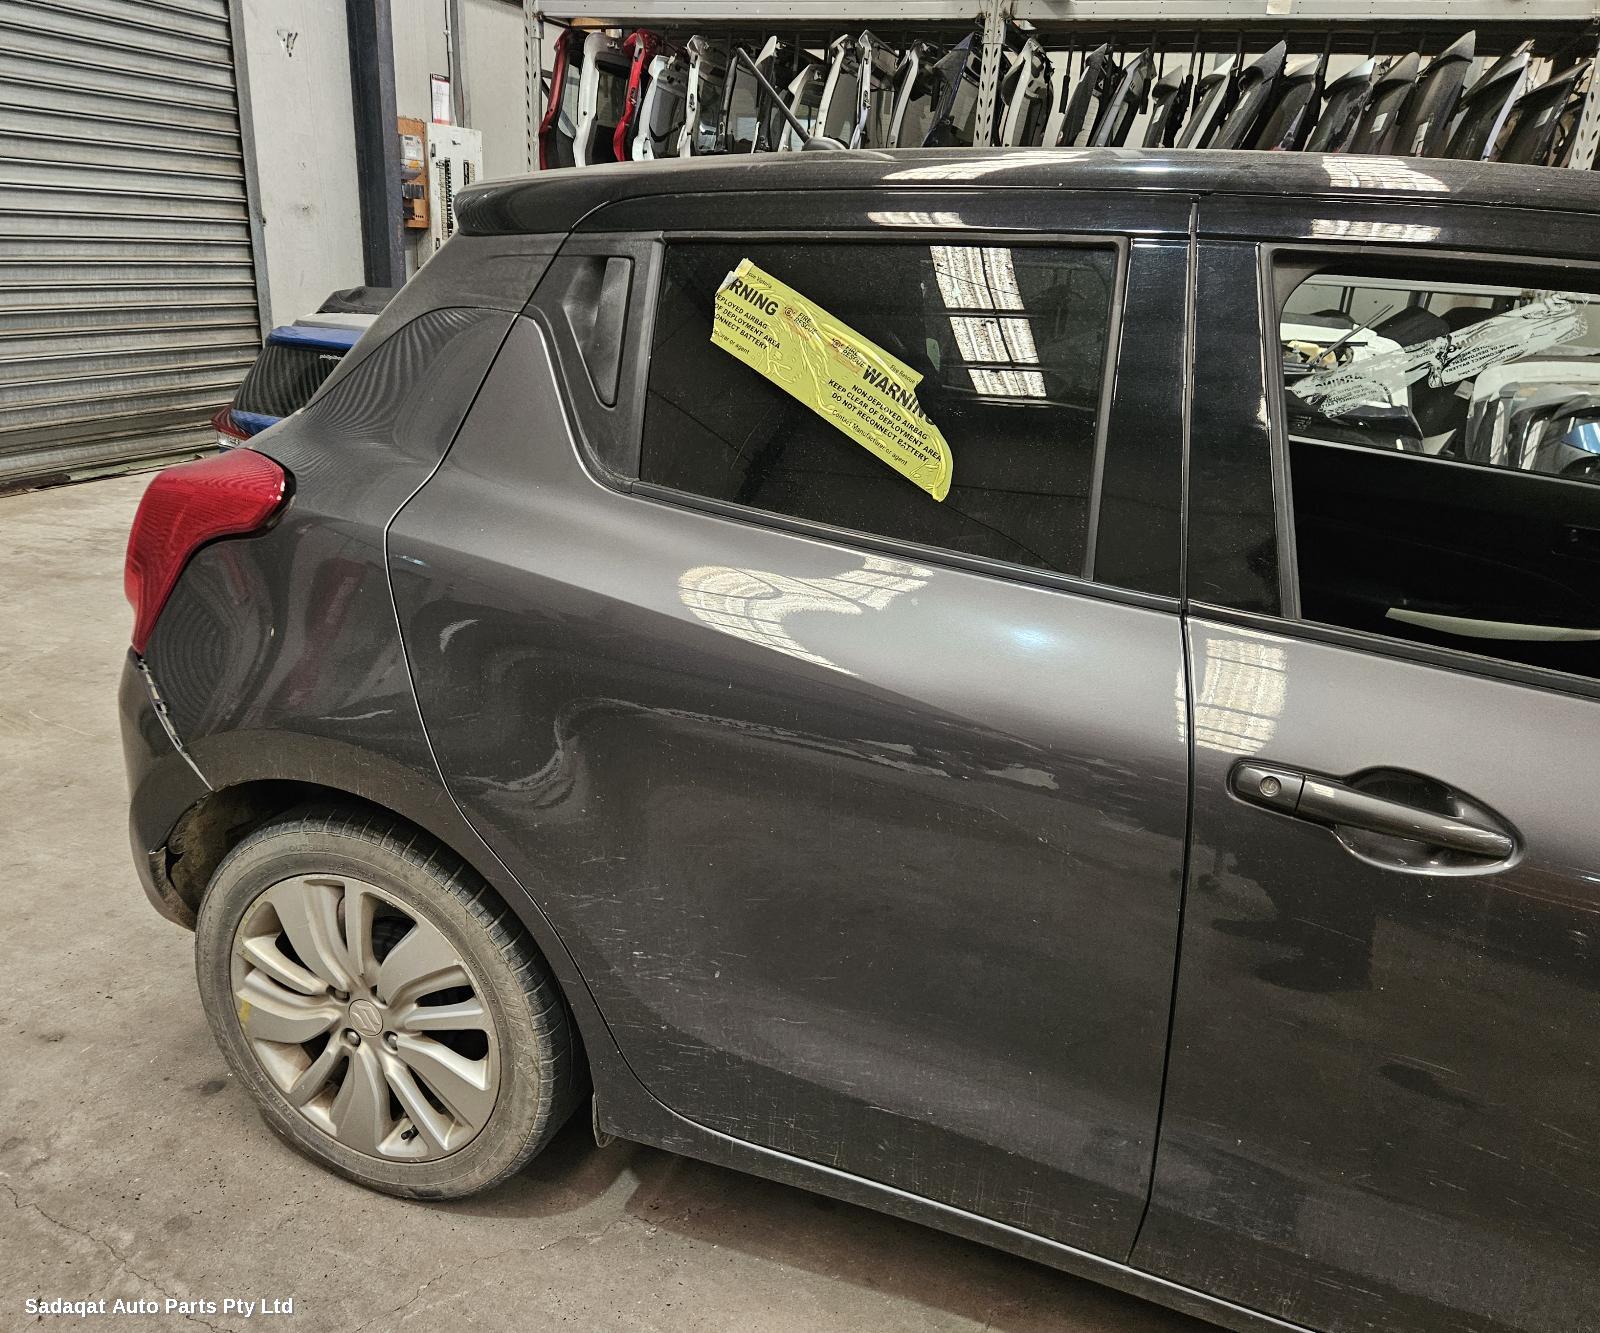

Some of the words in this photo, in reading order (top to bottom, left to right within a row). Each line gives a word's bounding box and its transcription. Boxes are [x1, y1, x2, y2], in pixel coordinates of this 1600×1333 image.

[726, 278, 779, 317] RNING
[713, 312, 739, 332] ONNECT
[738, 328, 768, 351] BATTERY
[722, 307, 763, 338] DEPLOYMENT
[762, 334, 781, 349] AREA
[743, 311, 768, 330] AIRBAG
[733, 342, 750, 356] agent
[840, 348, 866, 368] RESCUE
[827, 379, 846, 394] KEEP
[845, 391, 869, 410] CLEAR
[867, 406, 879, 417] OF
[877, 413, 924, 448] DEPLOYMENT
[922, 444, 943, 462] AREA
[830, 391, 842, 402] DO
[840, 398, 857, 412] NOT
[855, 409, 898, 441] RECONNECT
[896, 438, 929, 463] BATTERY
[850, 384, 902, 422] NON-DEPLOYED
[900, 418, 928, 440] AIRBAG
[830, 408, 853, 427] Contact
[849, 422, 887, 450] Manufacturer
[884, 447, 892, 455] or
[890, 451, 908, 467] agent
